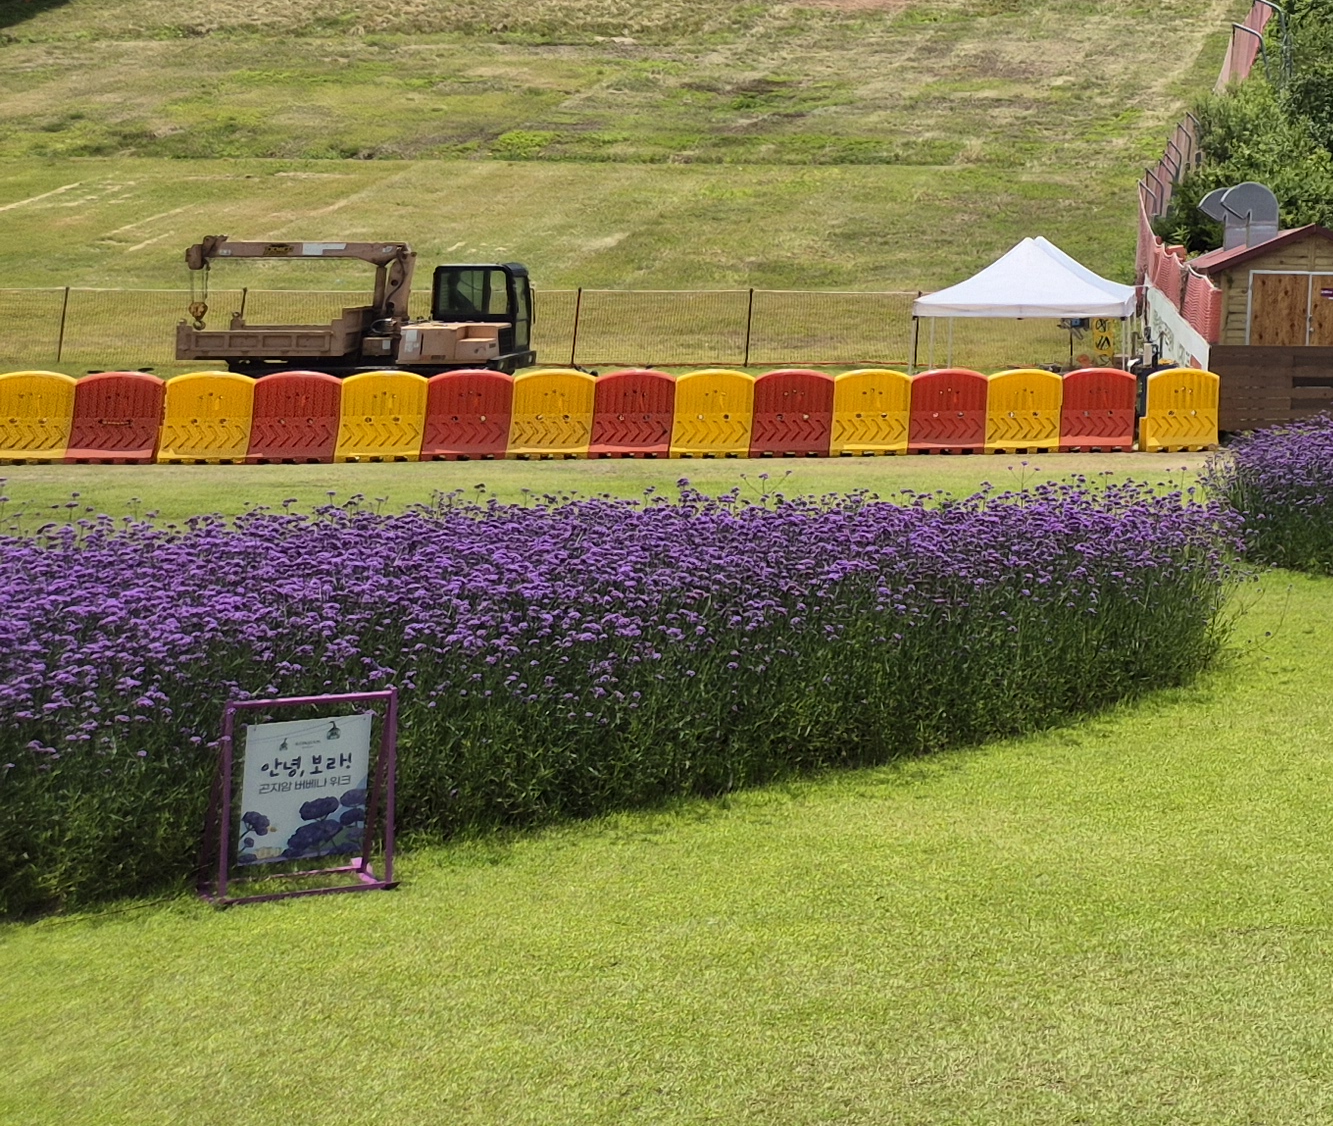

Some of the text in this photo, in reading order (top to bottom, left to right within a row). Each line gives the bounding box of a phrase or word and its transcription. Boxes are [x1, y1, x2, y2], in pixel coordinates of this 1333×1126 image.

[260, 752, 353, 778] 안녕, 보라!
[258, 774, 352, 795] 곤지암 버베나 위크
